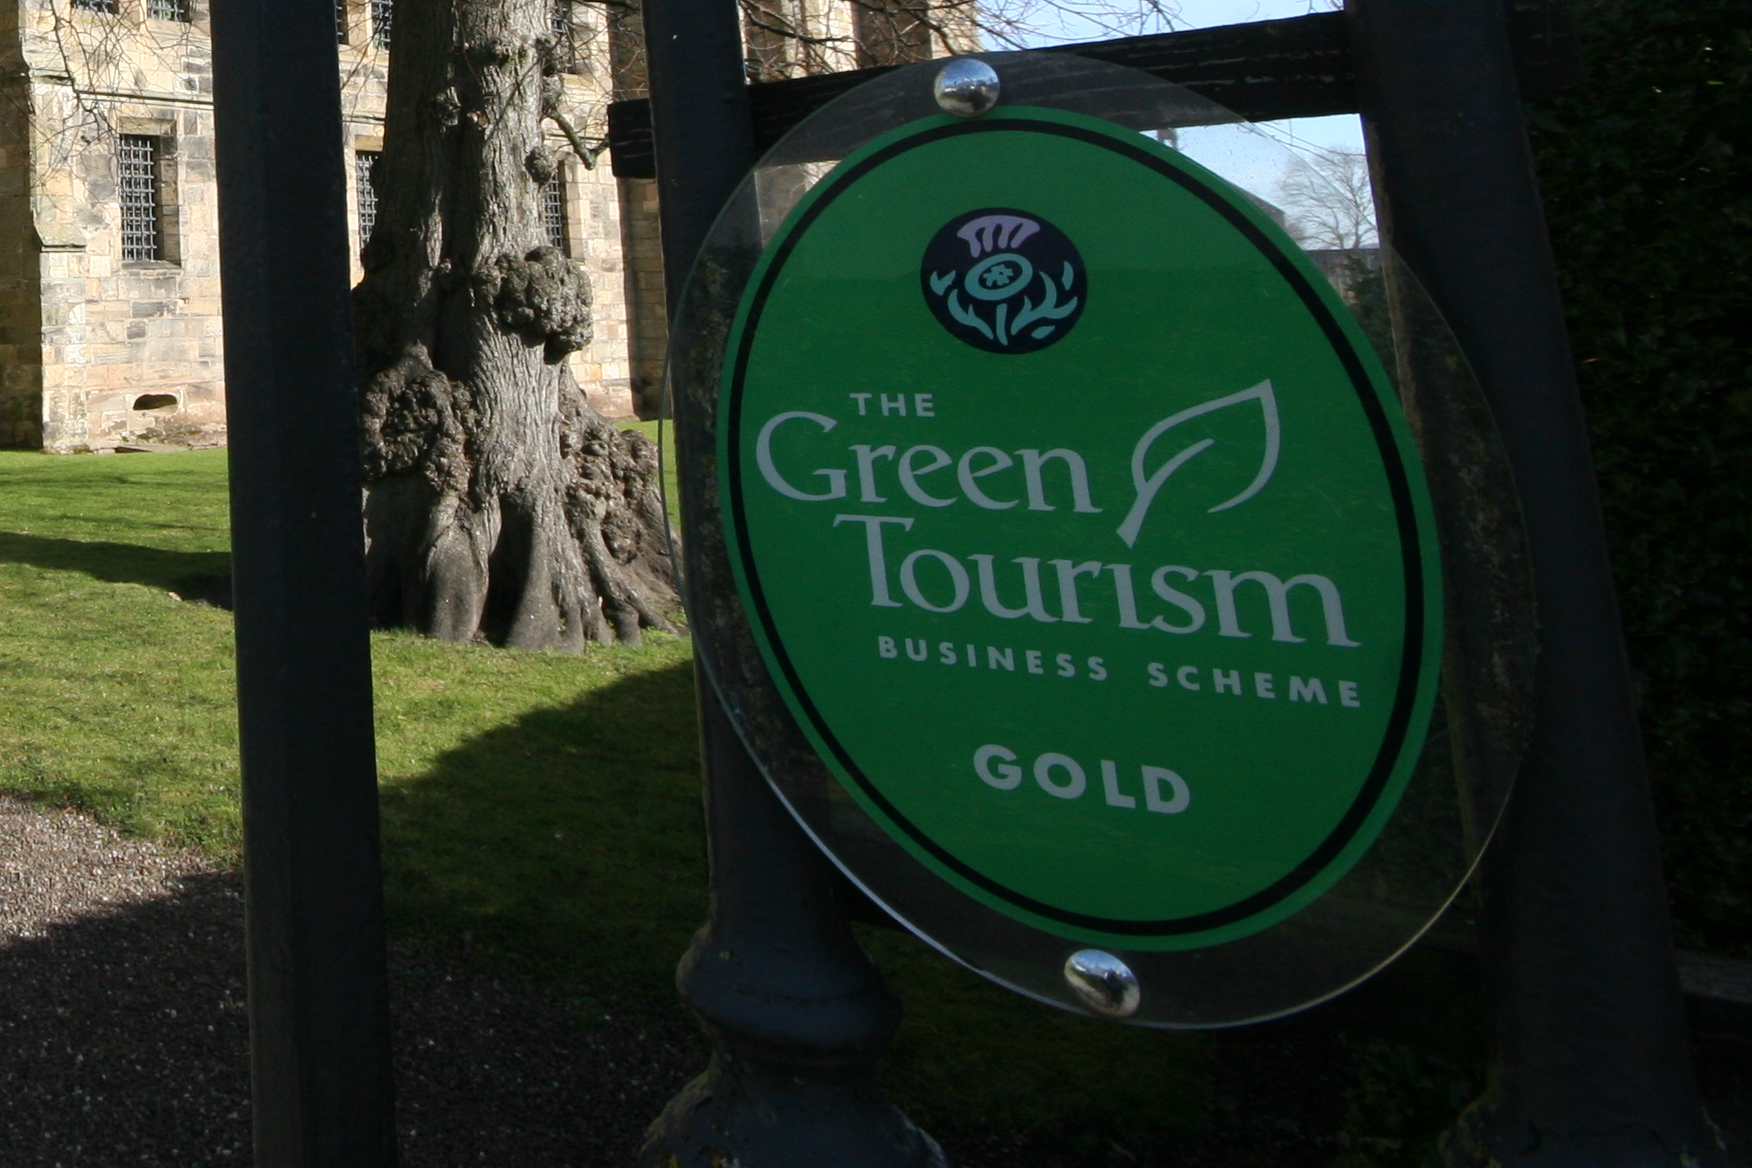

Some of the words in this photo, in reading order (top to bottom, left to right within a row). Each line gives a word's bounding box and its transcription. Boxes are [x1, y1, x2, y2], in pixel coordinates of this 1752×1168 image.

[849, 392, 935, 419] THE
[755, 410, 1101, 514] Green
[833, 513, 1360, 649] Tourism
[877, 635, 1109, 682] BUSINESS
[1147, 661, 1361, 709] SCHEME
[973, 743, 1190, 815] GOLD
